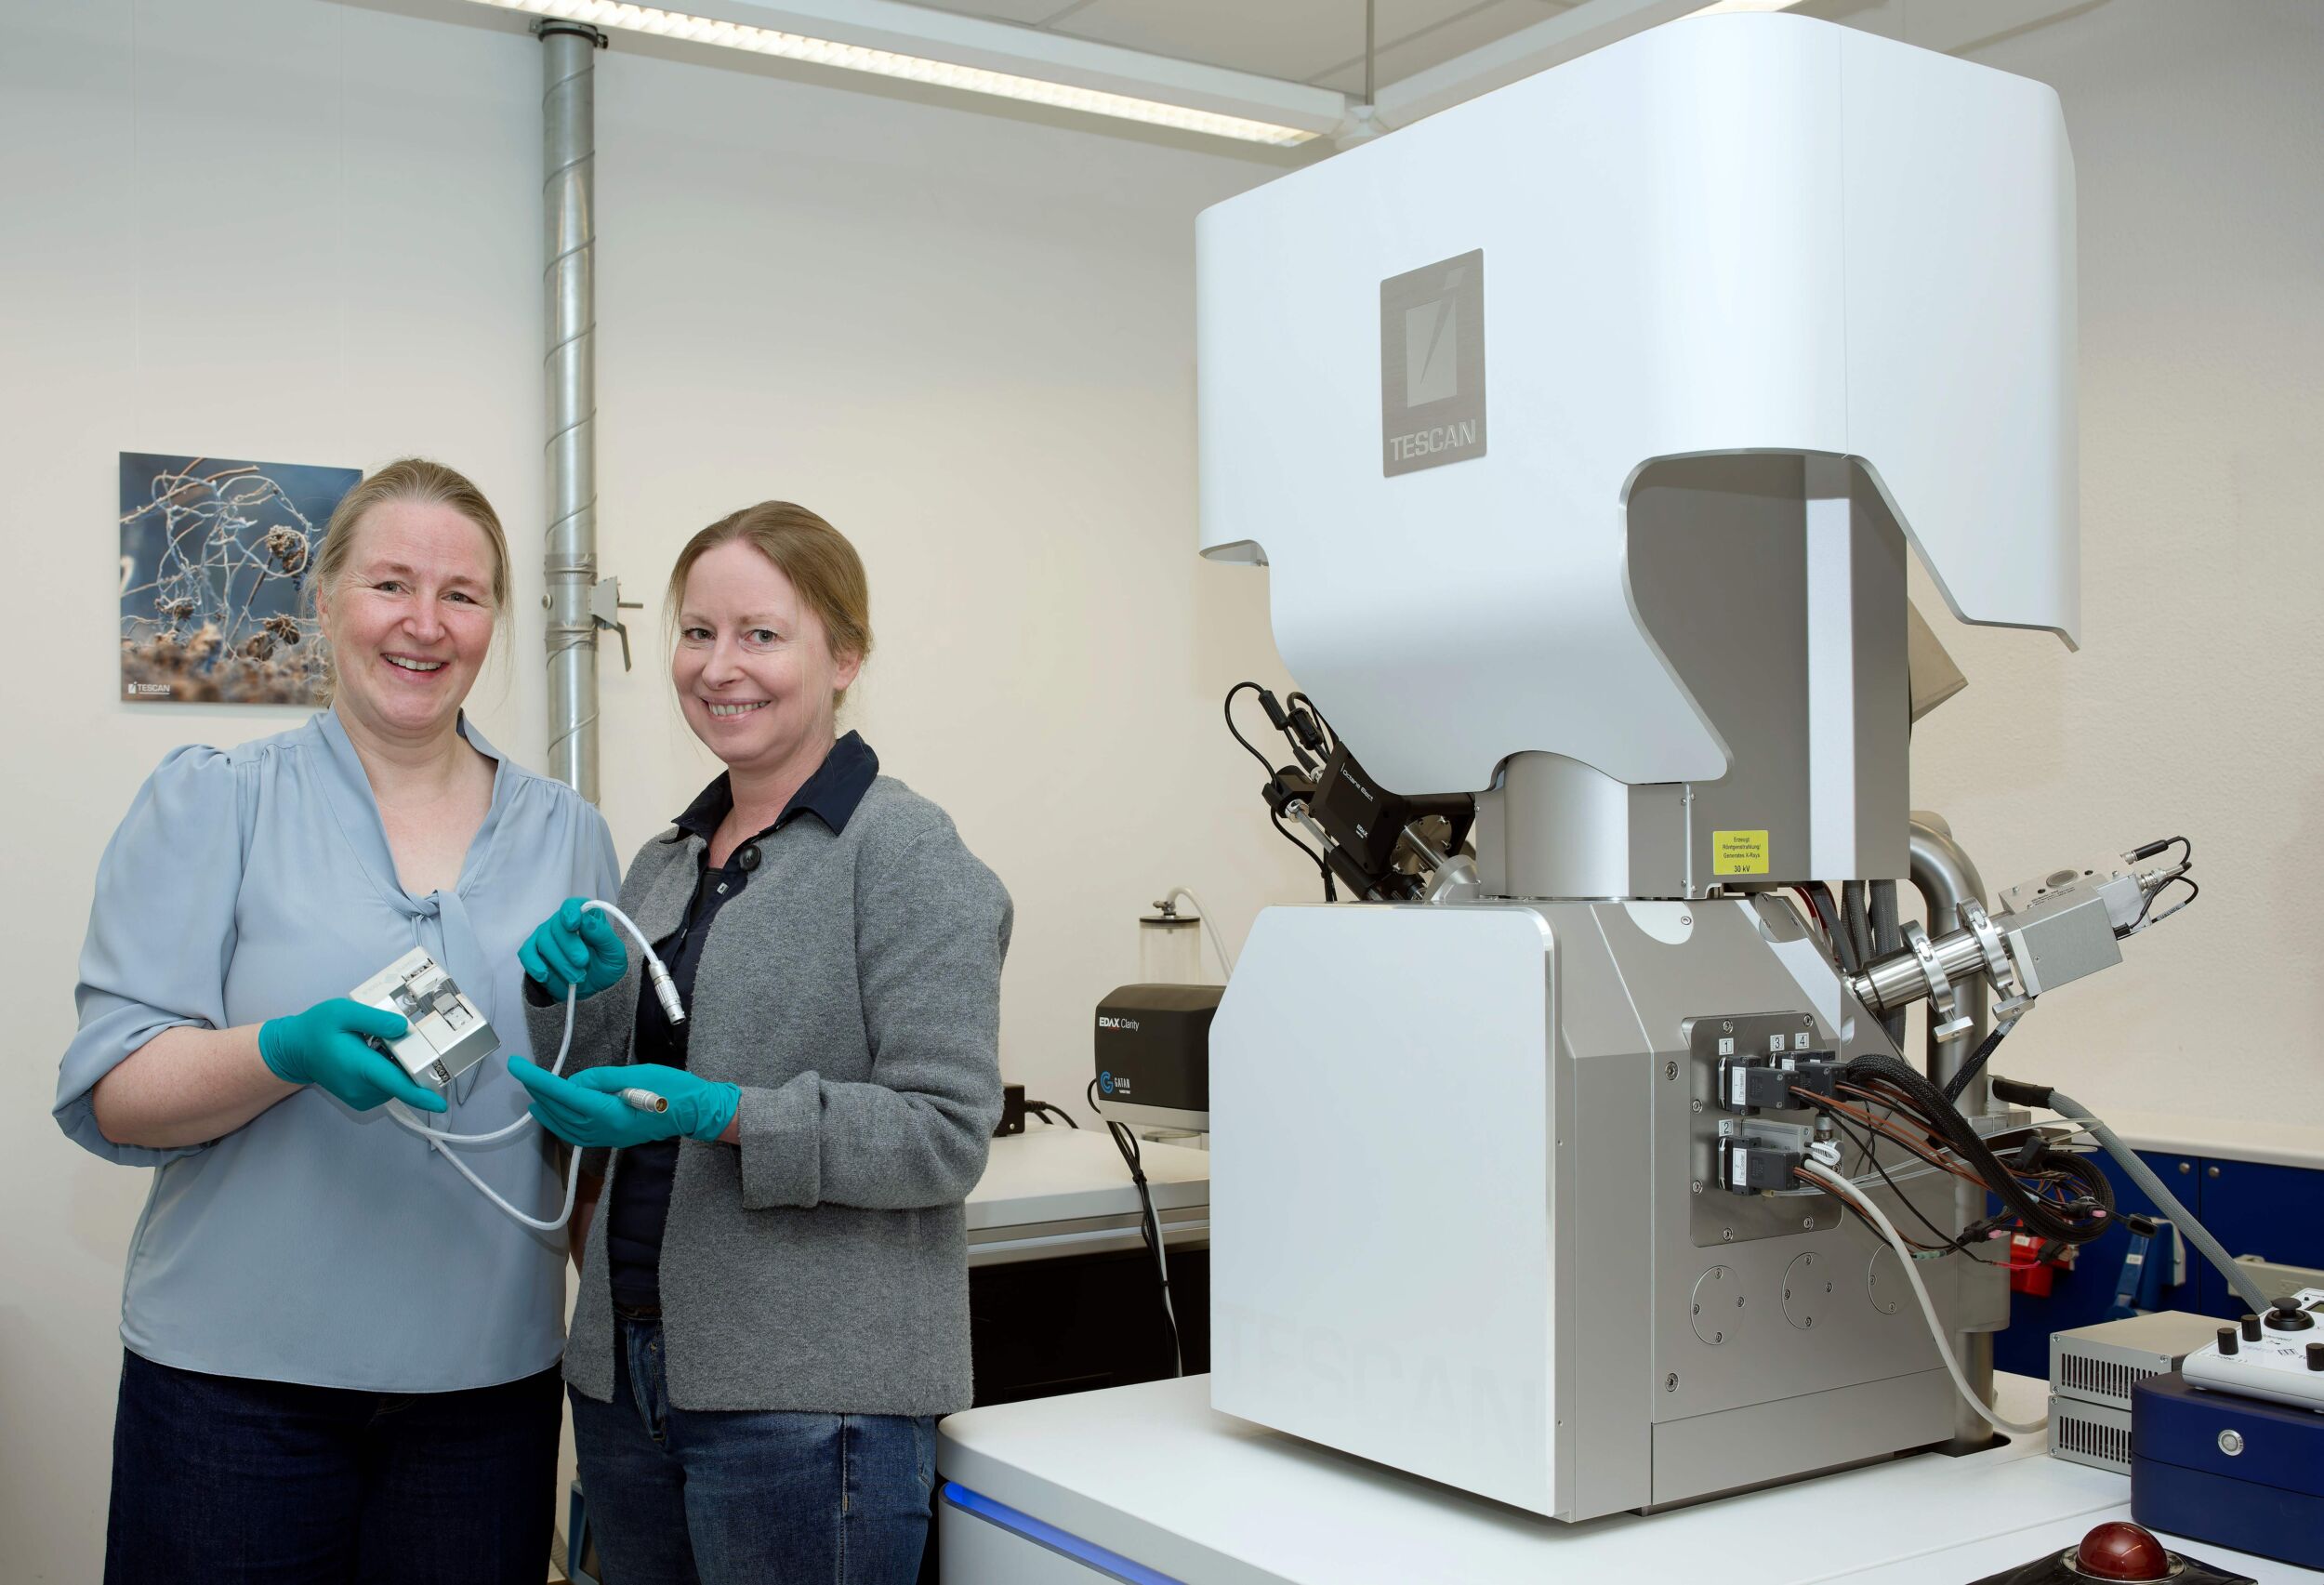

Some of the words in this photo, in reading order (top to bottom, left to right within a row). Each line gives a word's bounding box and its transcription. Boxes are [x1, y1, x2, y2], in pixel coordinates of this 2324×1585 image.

[1390, 419, 1476, 461] TESCAN
[137, 683, 171, 693] TESCAN
[1742, 865, 1750, 873] kV
[1099, 1016, 1119, 1028] EDAX
[1120, 1018, 1140, 1032] Clarity
[1775, 1037, 1780, 1049] 3
[1799, 1036, 1805, 1047] 4
[1723, 1122, 1729, 1134] 2
